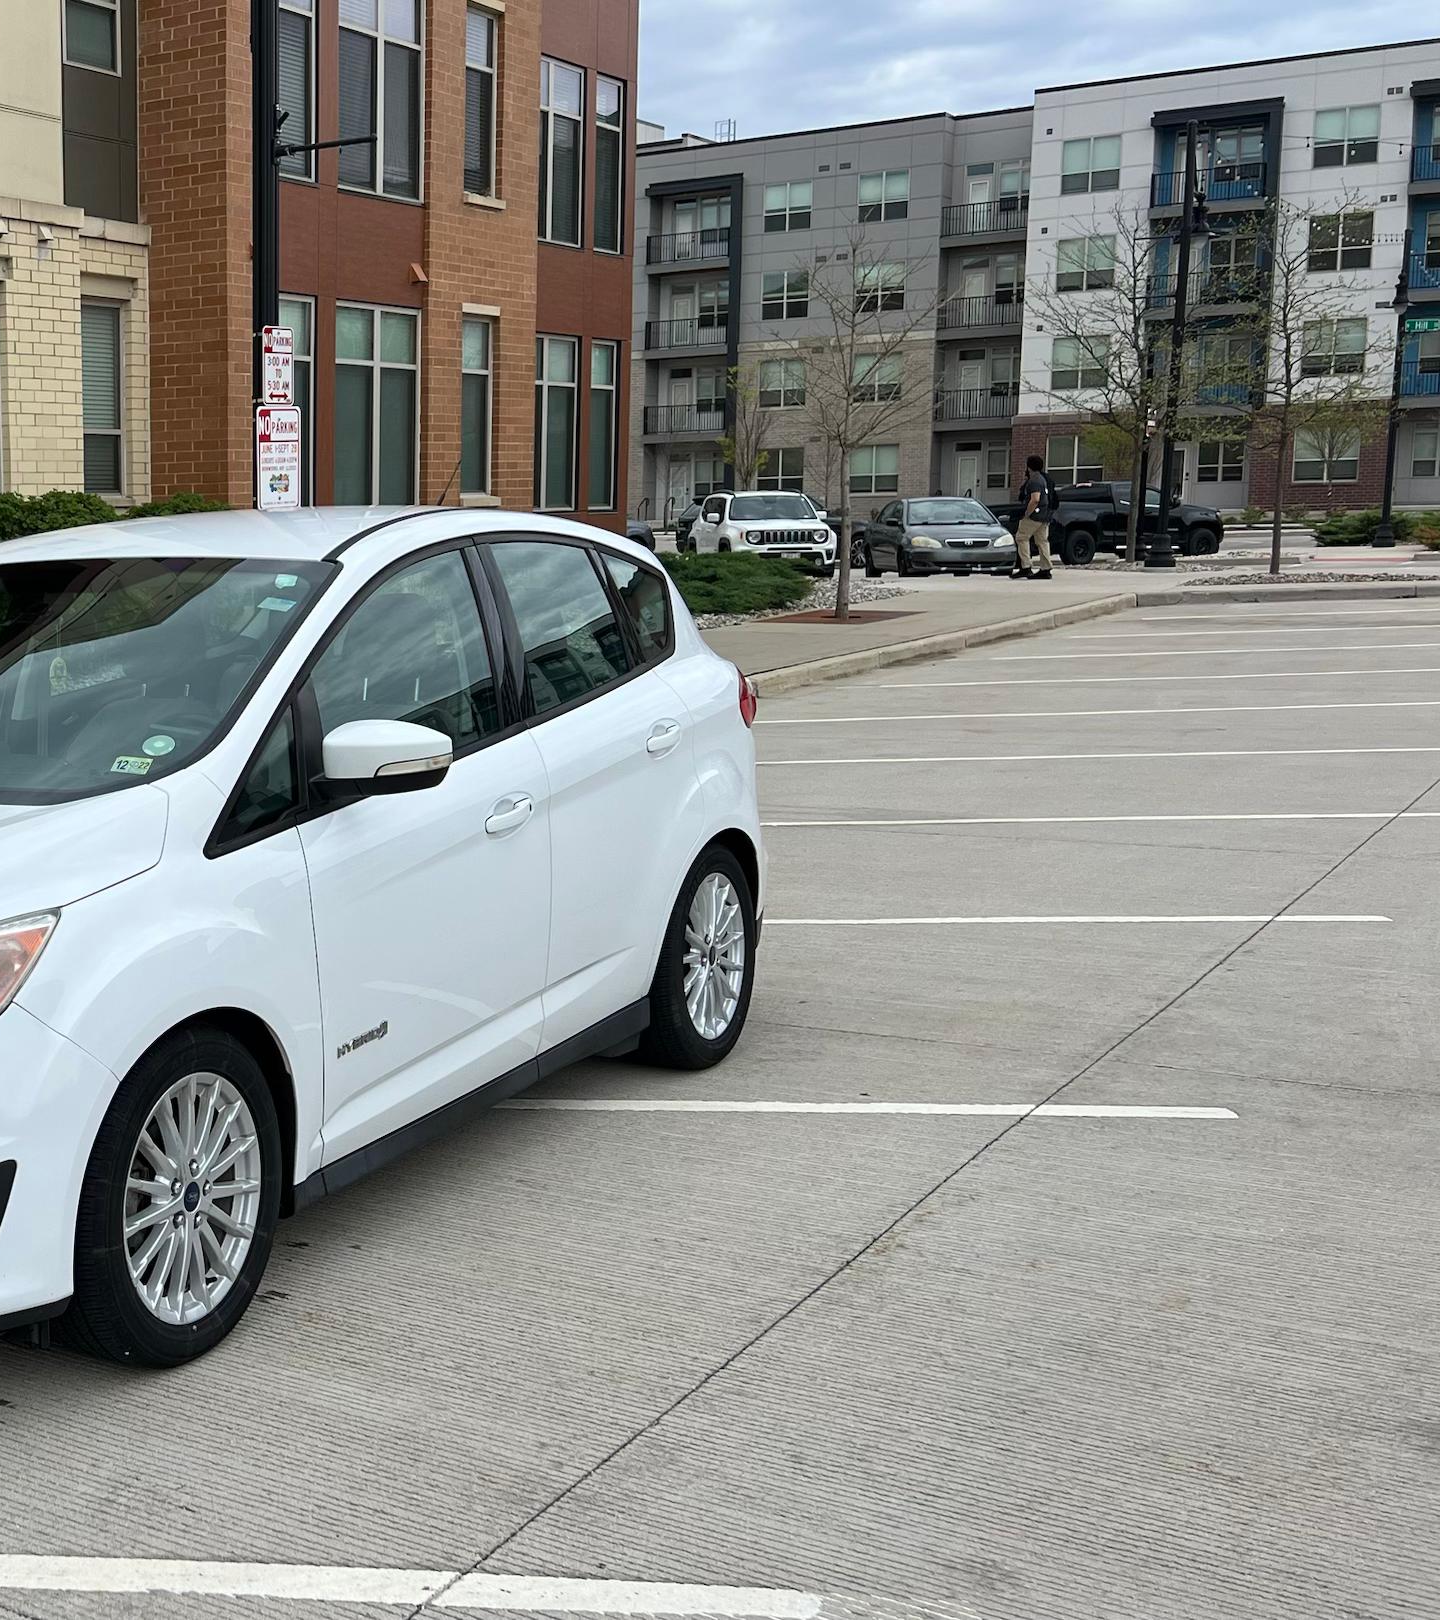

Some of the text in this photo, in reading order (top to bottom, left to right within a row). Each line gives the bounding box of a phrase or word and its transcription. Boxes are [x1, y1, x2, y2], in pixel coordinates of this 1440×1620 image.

[1415, 321, 1428, 330] Hill
[264, 333, 292, 348] NO PARKING
[281, 357, 290, 366] AM
[275, 368, 282, 379] TO
[281, 381, 290, 391] AM
[259, 416, 297, 435] NO PARKING
[262, 443, 273, 454] JUNE
[116, 760, 129, 770] 12
